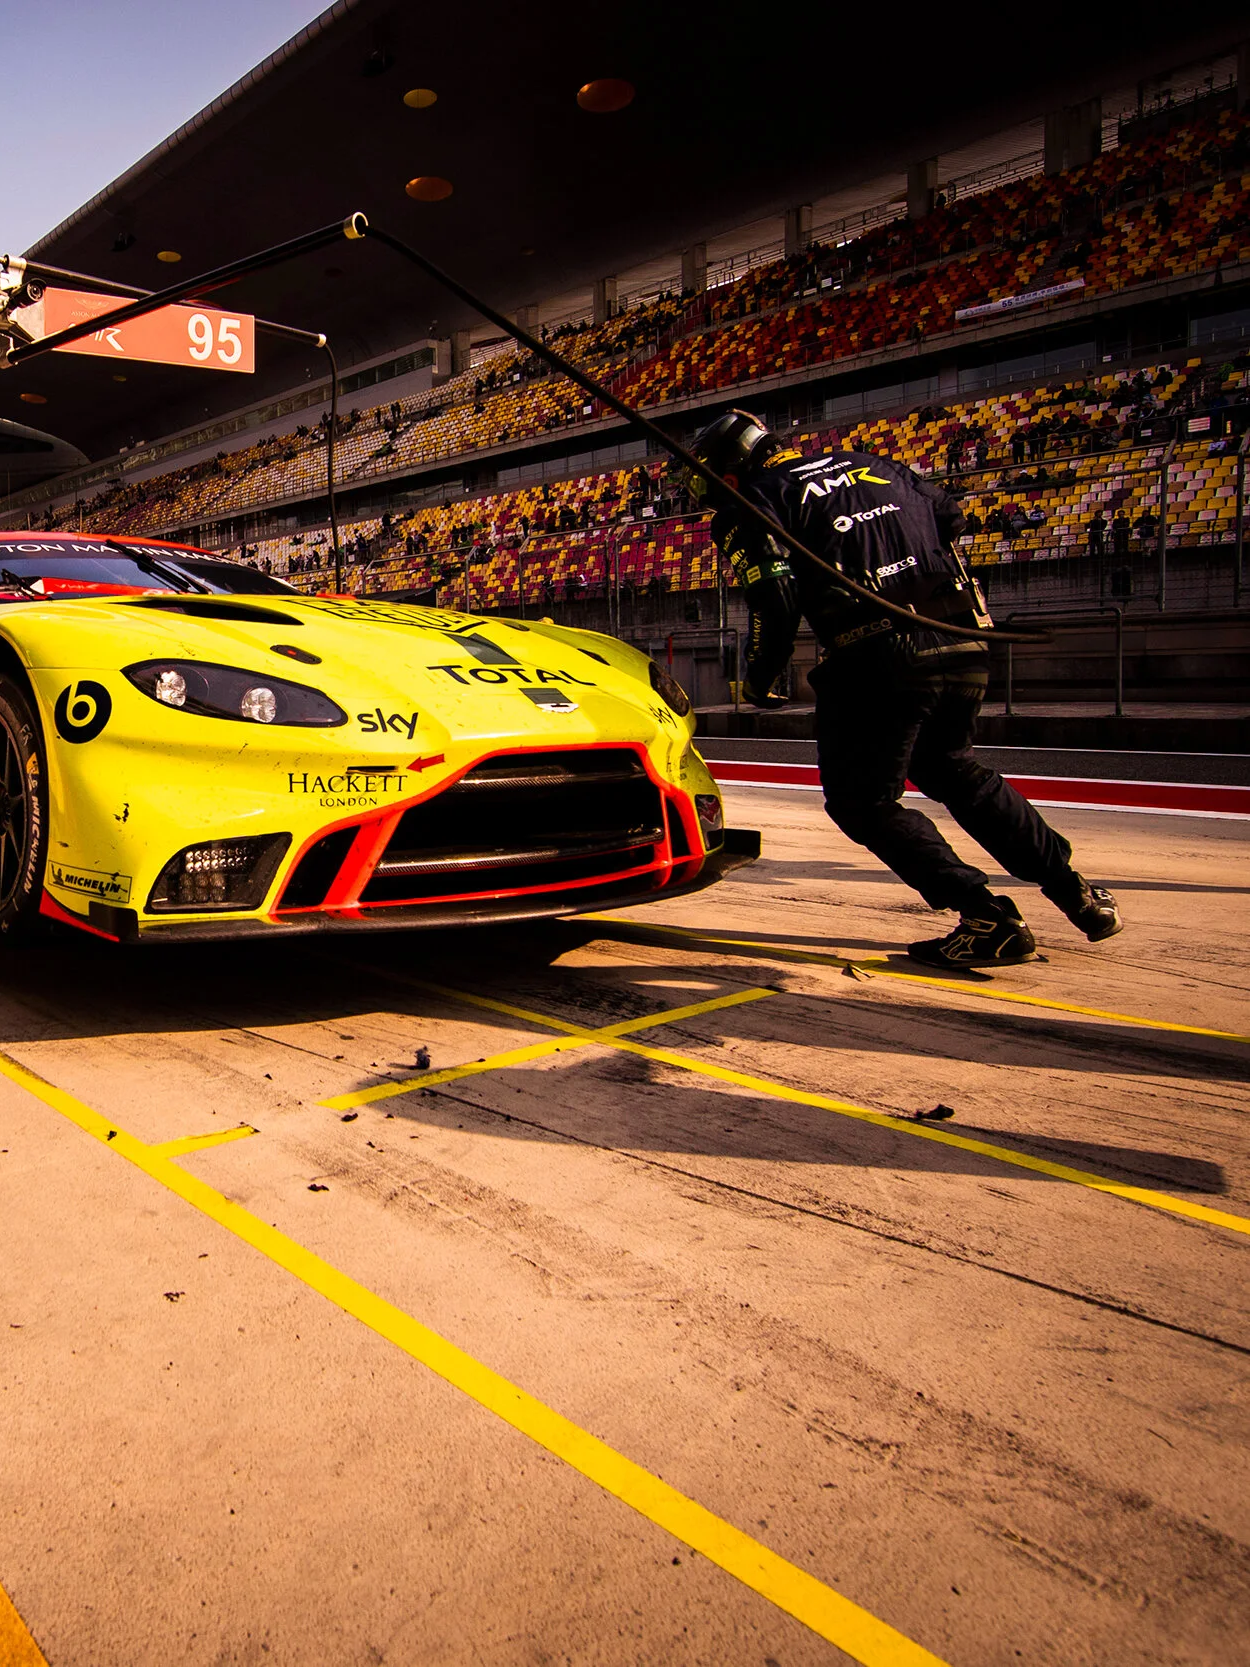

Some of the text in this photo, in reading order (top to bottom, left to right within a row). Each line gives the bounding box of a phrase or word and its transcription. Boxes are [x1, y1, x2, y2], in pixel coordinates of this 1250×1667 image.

[186, 312, 243, 365] 95
[801, 466, 892, 505] AMR
[851, 503, 901, 523] TOTAL
[72, 544, 171, 558] MATIN
[426, 664, 597, 687] TOTAL
[356, 707, 419, 740] sky
[287, 772, 408, 794] HACKETT
[319, 797, 378, 808] LONDON
[23, 795, 41, 894] MICHELIN
[64, 873, 121, 894] MICHELIN
